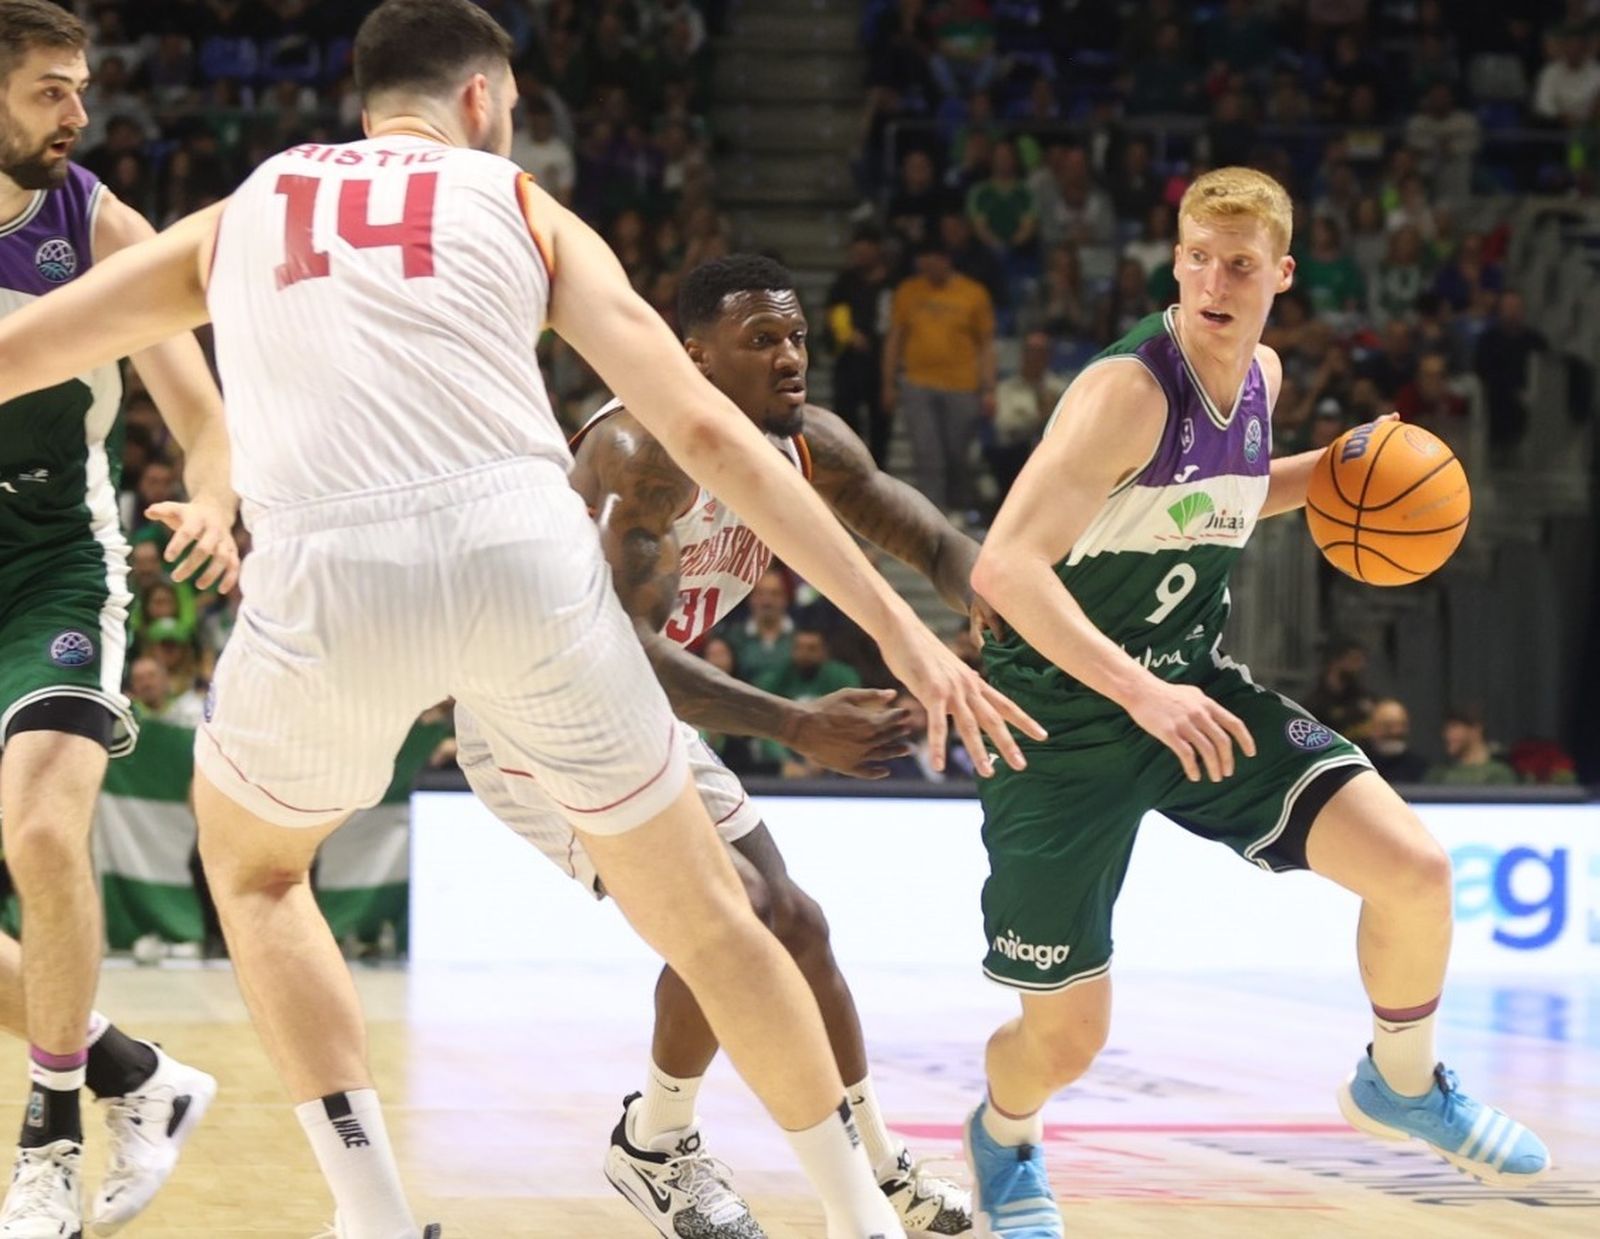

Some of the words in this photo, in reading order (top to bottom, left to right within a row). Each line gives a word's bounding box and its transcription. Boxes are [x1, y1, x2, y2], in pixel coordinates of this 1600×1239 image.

[274, 171, 438, 291] 14
[665, 587, 720, 644] 31
[1145, 562, 1197, 624] 9
[332, 1117, 370, 1149] NIKE
